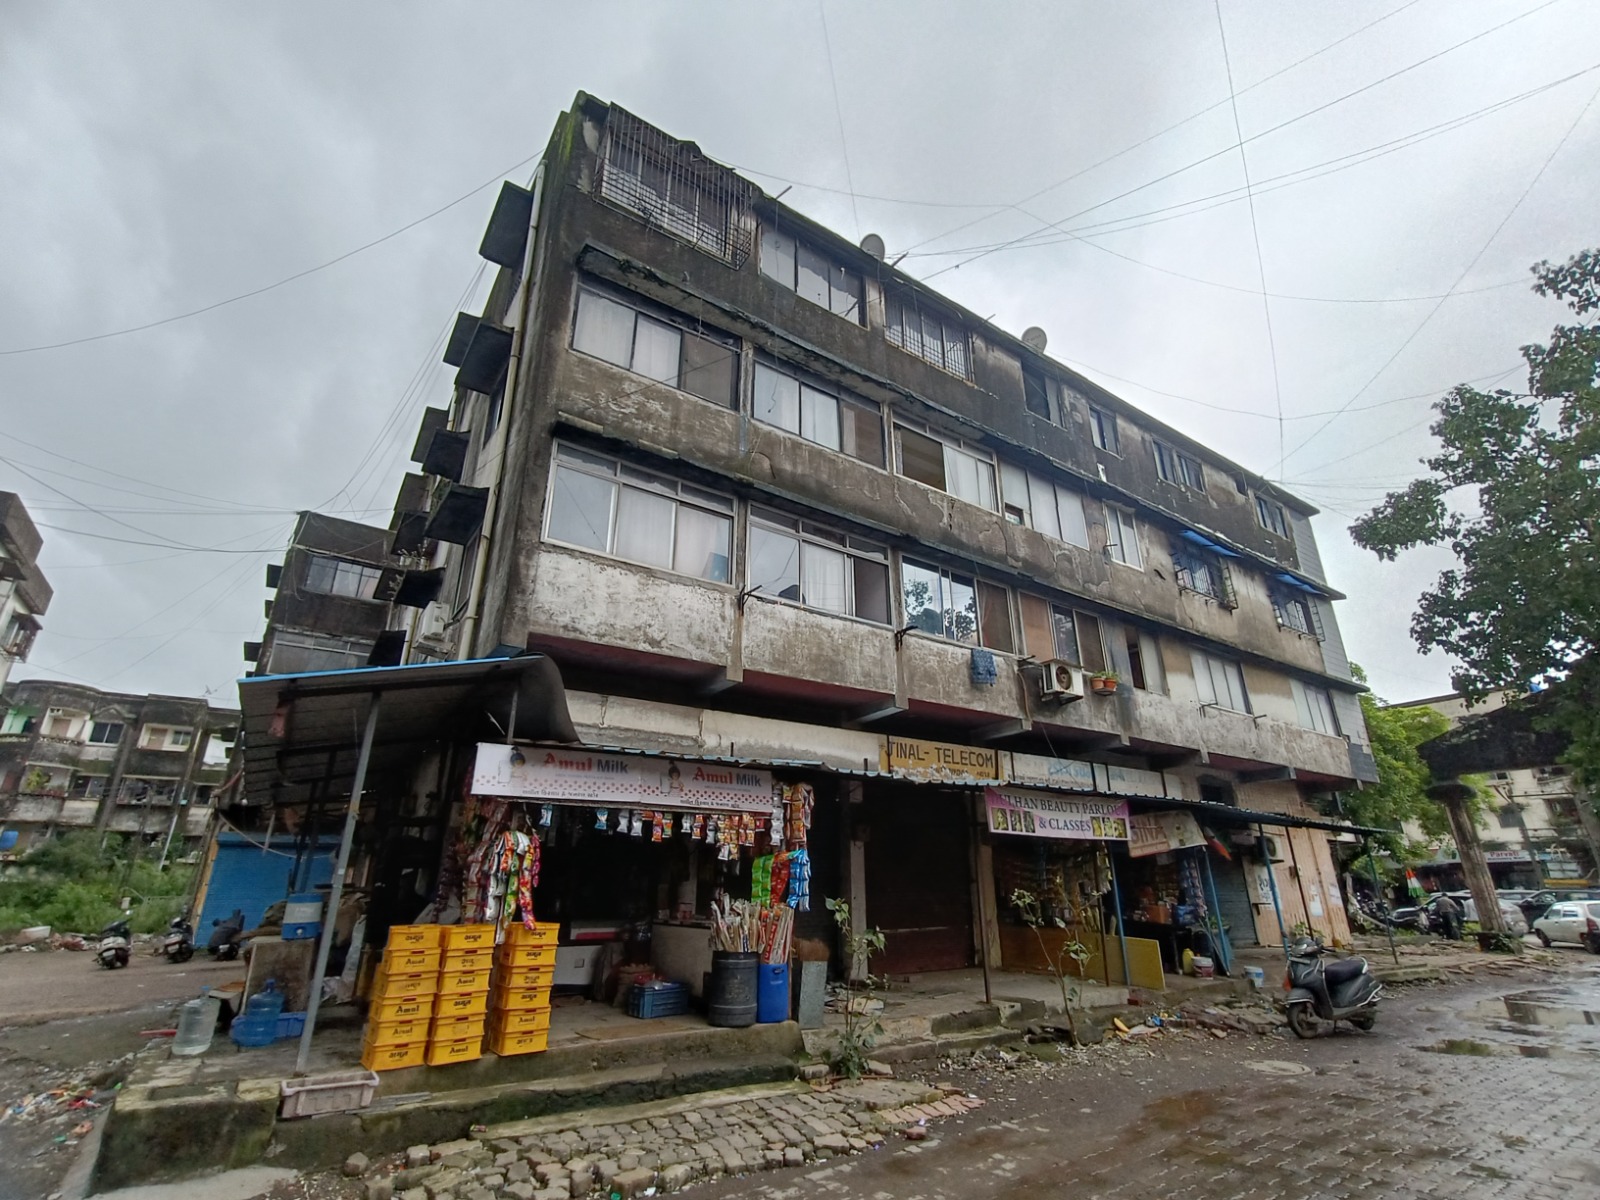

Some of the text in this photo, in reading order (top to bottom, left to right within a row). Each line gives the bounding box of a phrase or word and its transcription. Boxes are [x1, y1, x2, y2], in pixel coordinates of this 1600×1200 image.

[543, 752, 629, 774] Amul Milk
[934, 747, 994, 768] TELECOM
[692, 766, 762, 787] Amul Milk
[1040, 799, 1080, 814] BEAUTY
[1038, 817, 1092, 832] & CLASSES
[396, 1004, 420, 1014] Amul
